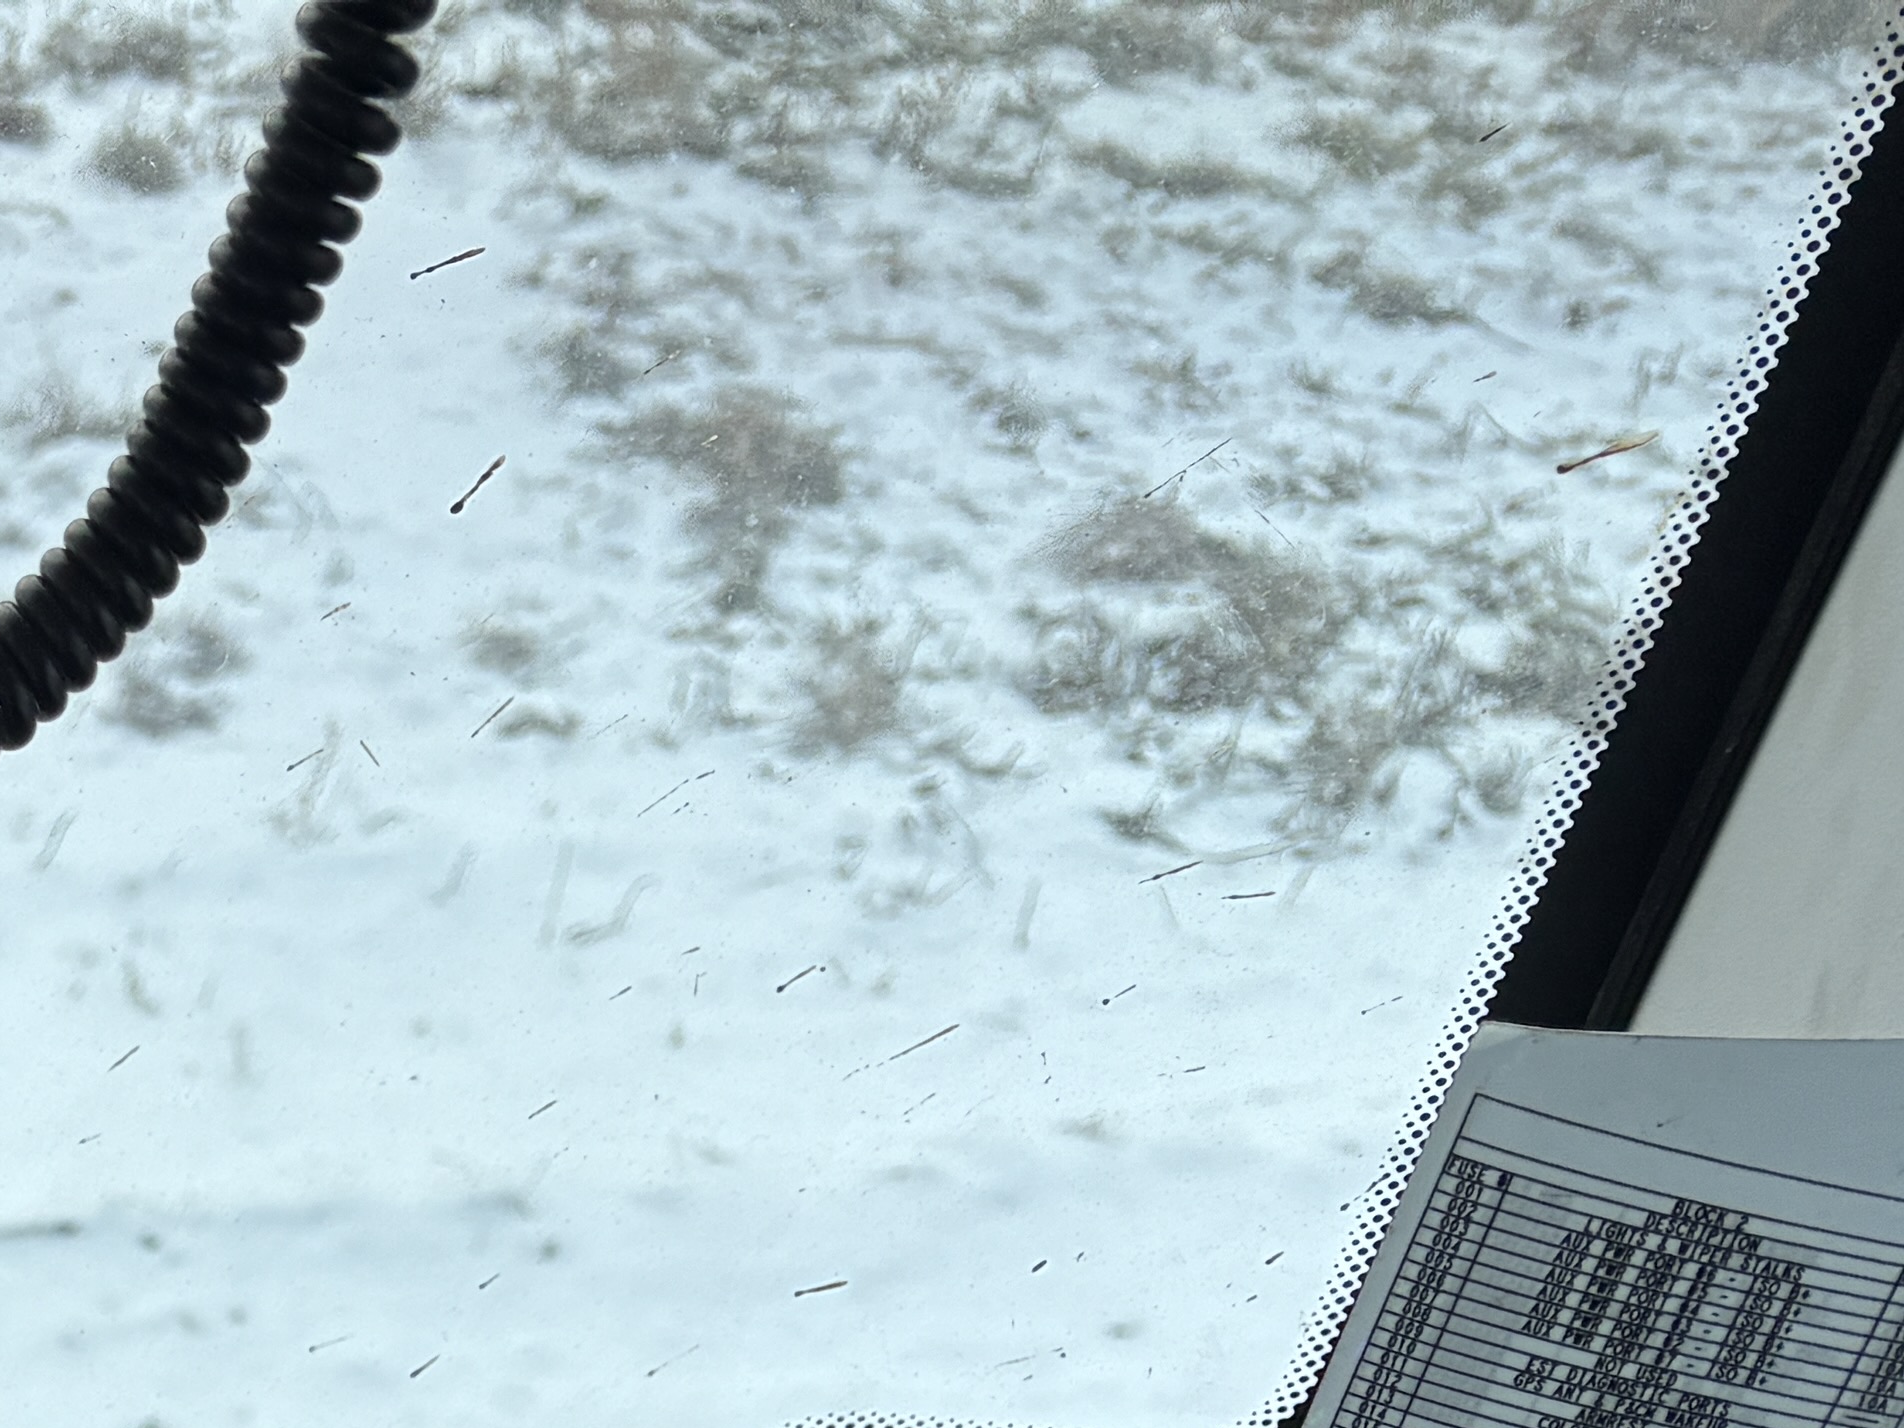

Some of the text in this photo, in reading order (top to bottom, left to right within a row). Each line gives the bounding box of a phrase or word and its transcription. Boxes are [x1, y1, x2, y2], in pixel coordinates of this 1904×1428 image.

[1445, 1157, 1487, 1182] FUSE
[1643, 1213, 1762, 1253] DESCRIPTION
[1671, 1200, 1749, 1231] BLOCK 2
[1552, 1249, 1771, 1312] AUX PORT ISO
[1560, 1231, 1780, 1295] AUX PORT ISO
[1583, 1218, 1806, 1282] LIGHTS WIPER STALKS
[1536, 1283, 1755, 1346] AUX PORT ISO
[1544, 1266, 1763, 1330] AUX PORT ISO
[1520, 1318, 1738, 1381] AUX PORT ISO
[1528, 1300, 1746, 1364] AUX PORT ISO
[1511, 1372, 1545, 1391] GPS
[1566, 1366, 1671, 1403] DIAGNOSTIC
[1678, 1393, 1732, 1418] PORTS
[1593, 1355, 1679, 1387] NOT USED
